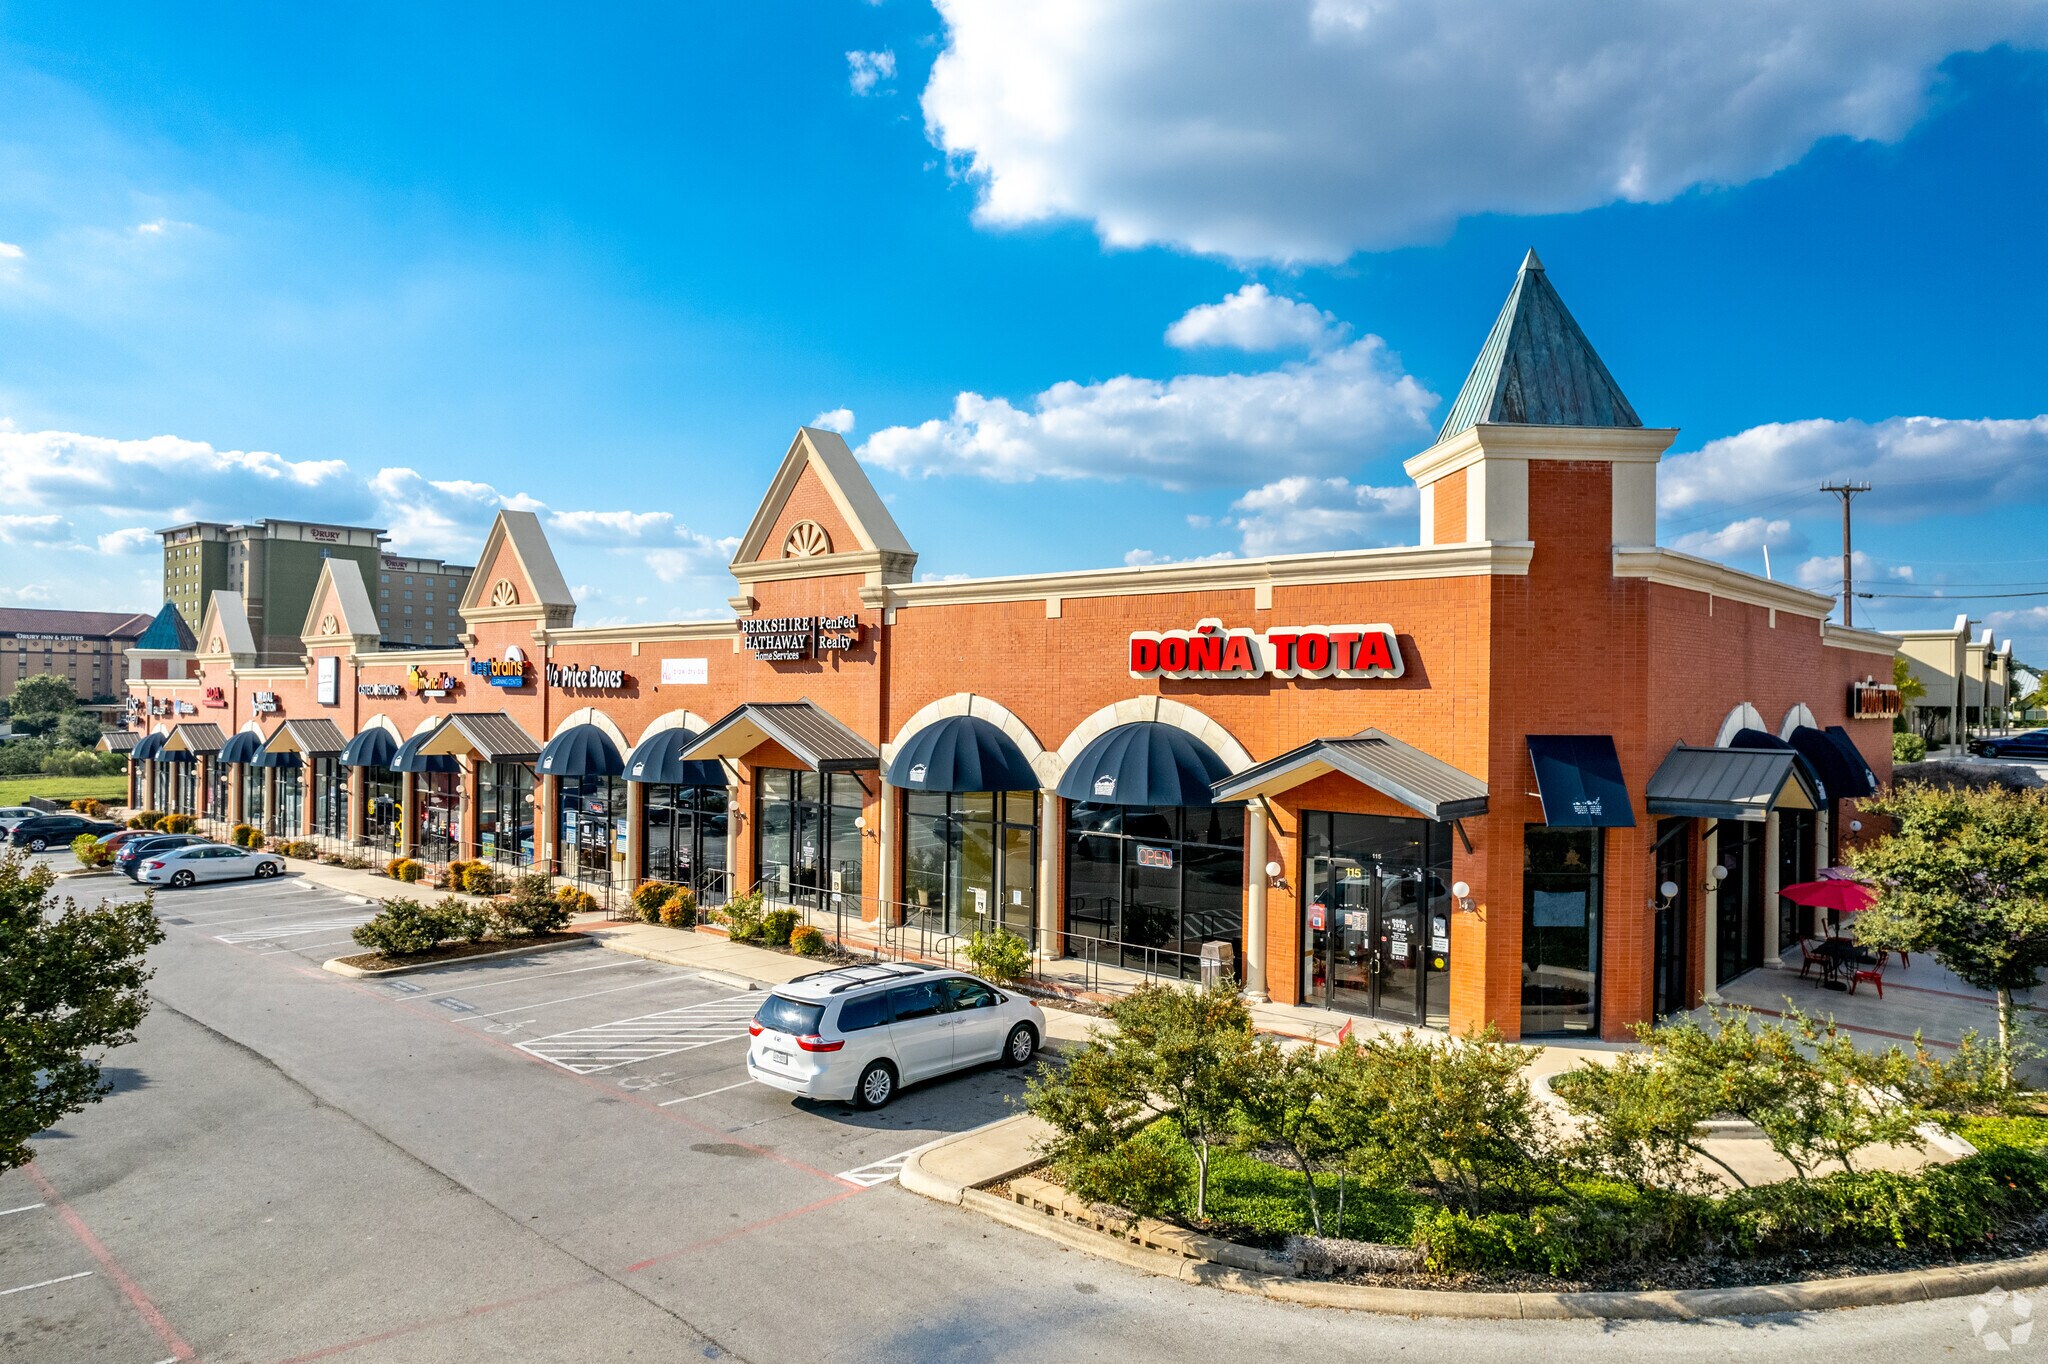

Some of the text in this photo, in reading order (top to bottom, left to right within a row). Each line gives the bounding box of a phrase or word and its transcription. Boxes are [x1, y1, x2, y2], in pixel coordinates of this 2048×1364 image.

[310, 528, 340, 538] DRURY
[384, 559, 408, 568] DRURY
[741, 618, 810, 634] BERKSHIRE
[819, 614, 856, 631] PenFed
[15, 632, 40, 640] DRURY
[744, 634, 807, 651] HATHAWAY
[819, 635, 852, 652] Realty
[1130, 625, 1394, 672] DOÑA TOTA
[562, 664, 587, 688] Price
[589, 665, 622, 689] Boxes
[1139, 848, 1172, 866] OPEN
[1345, 867, 1362, 878] 115
